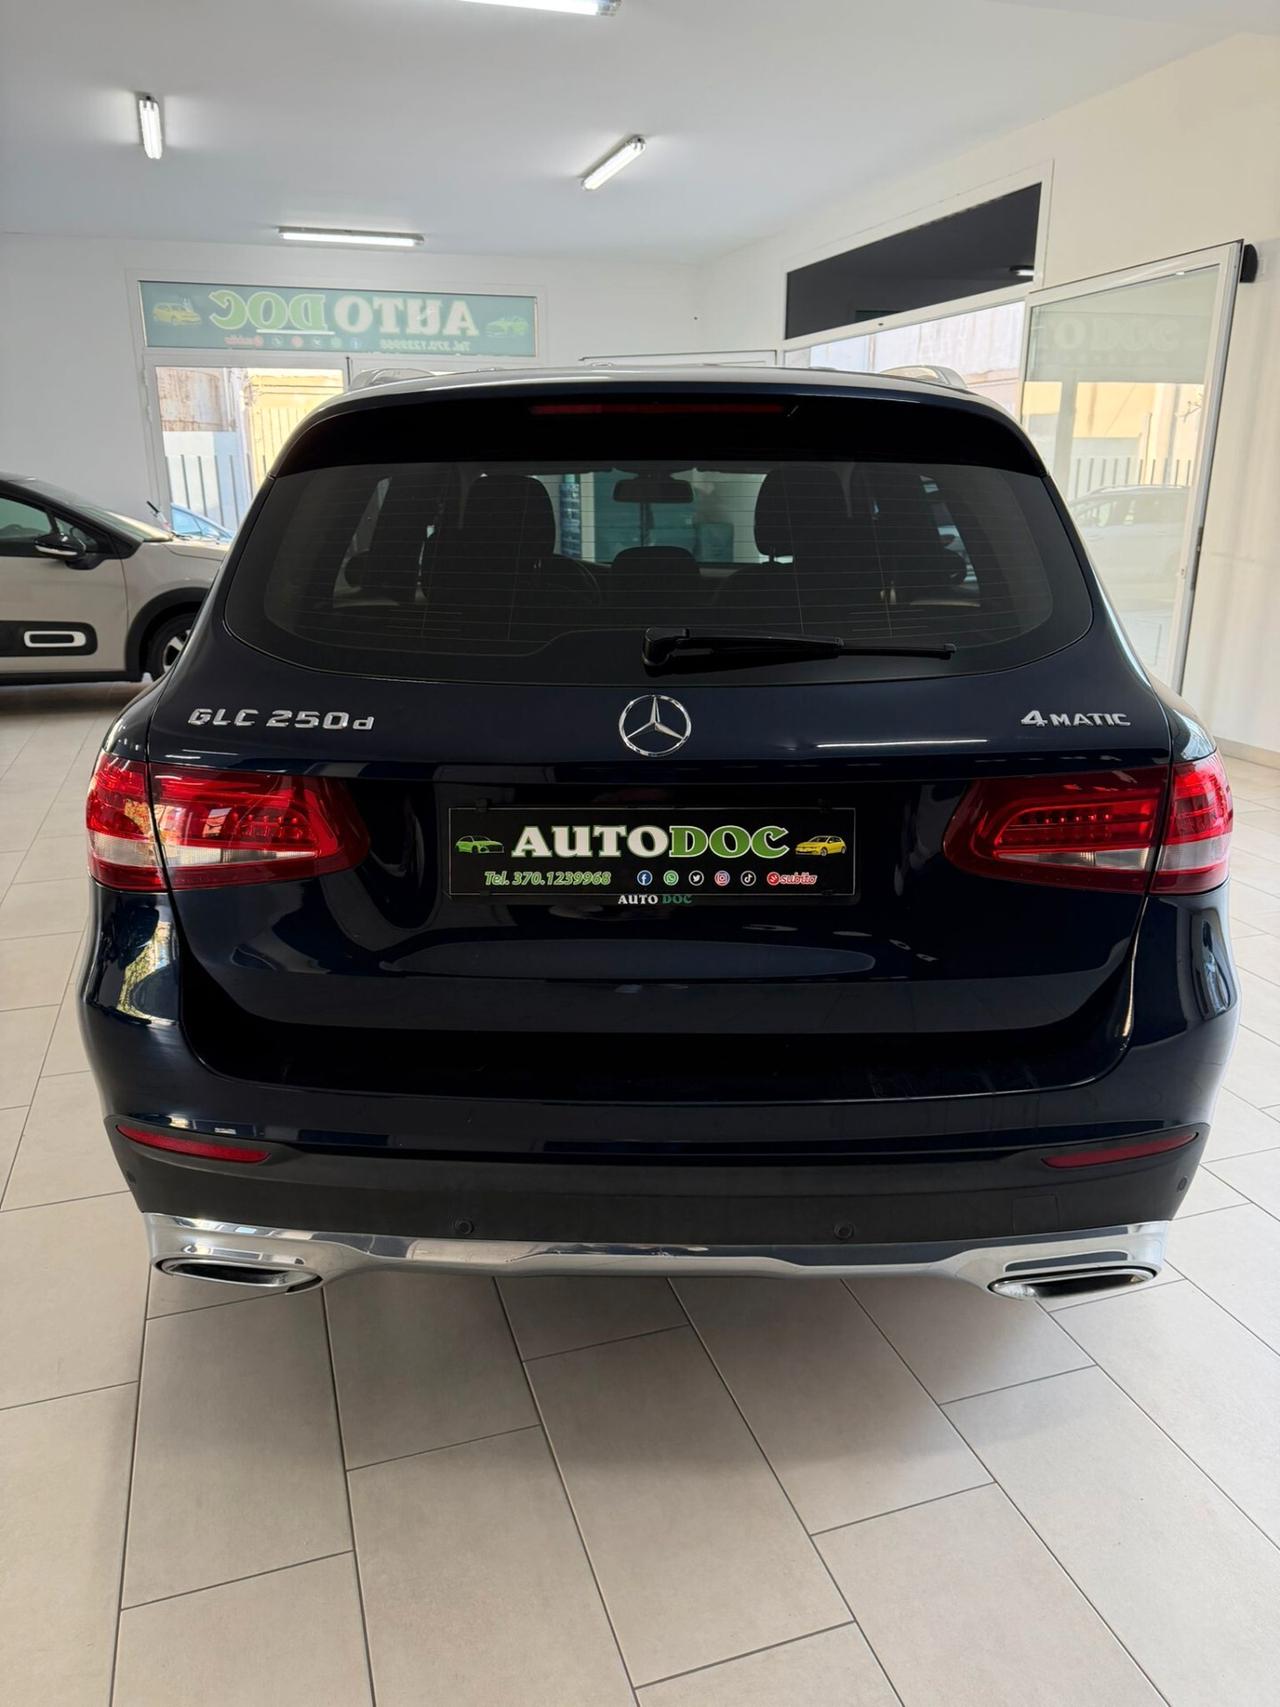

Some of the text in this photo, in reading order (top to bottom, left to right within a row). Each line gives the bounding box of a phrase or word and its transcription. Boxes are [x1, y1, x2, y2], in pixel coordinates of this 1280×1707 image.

[188, 708, 375, 730] GLC 250d
[484, 870, 612, 886] Tel. 370.1239968
[617, 894, 692, 905] AUTO DOC
